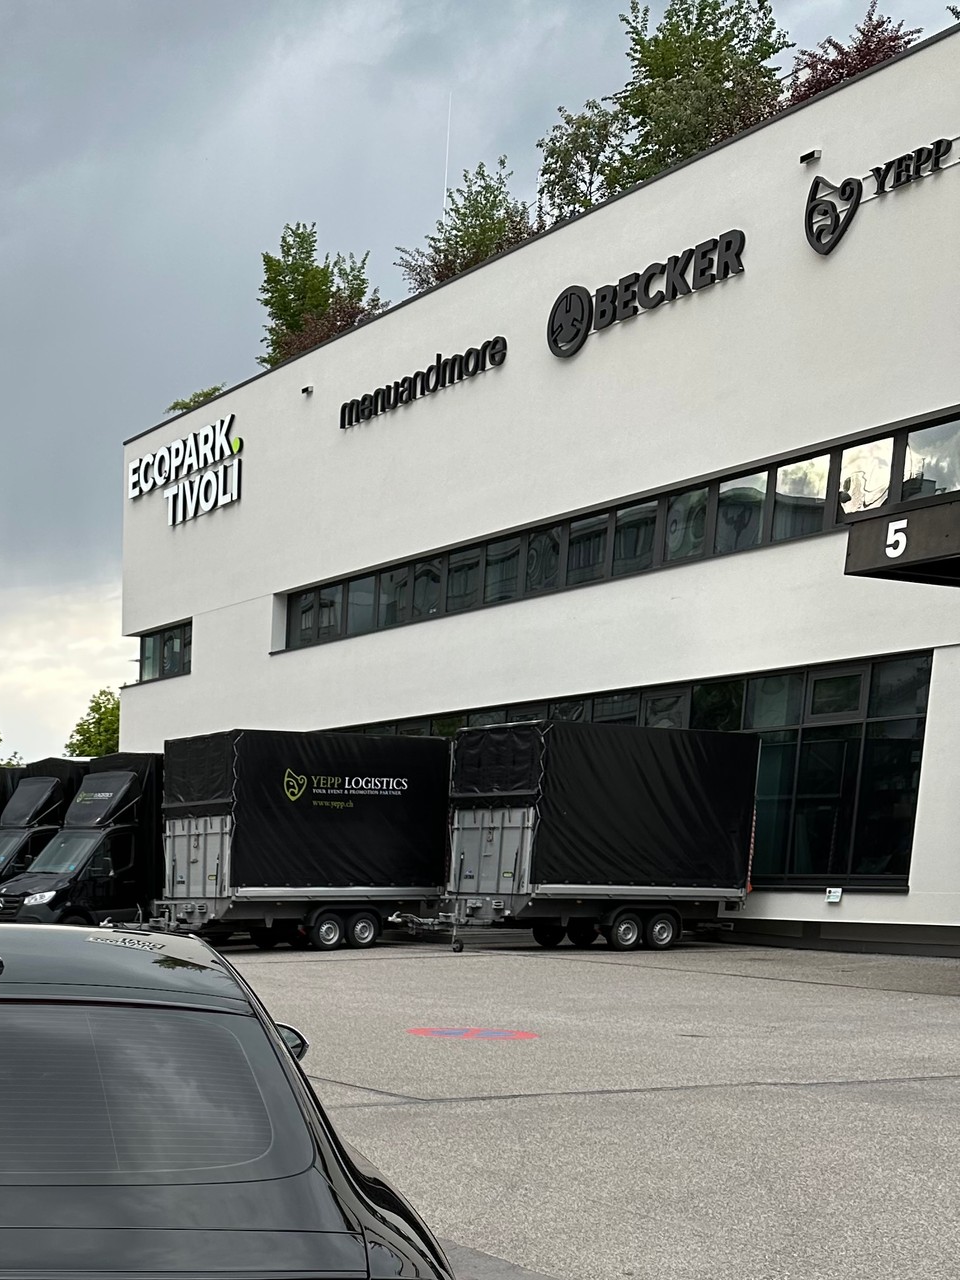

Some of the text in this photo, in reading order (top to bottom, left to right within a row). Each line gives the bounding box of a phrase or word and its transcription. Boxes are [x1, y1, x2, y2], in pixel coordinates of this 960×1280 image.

[869, 138, 953, 196] YEPP
[593, 229, 746, 330] BECKER
[339, 335, 508, 429] menuandmore
[163, 458, 243, 526] TIVOLI
[884, 518, 909, 559] 5
[311, 775, 408, 790] YEPP LOGISTICS
[312, 800, 354, 809] www.yepp.ch
